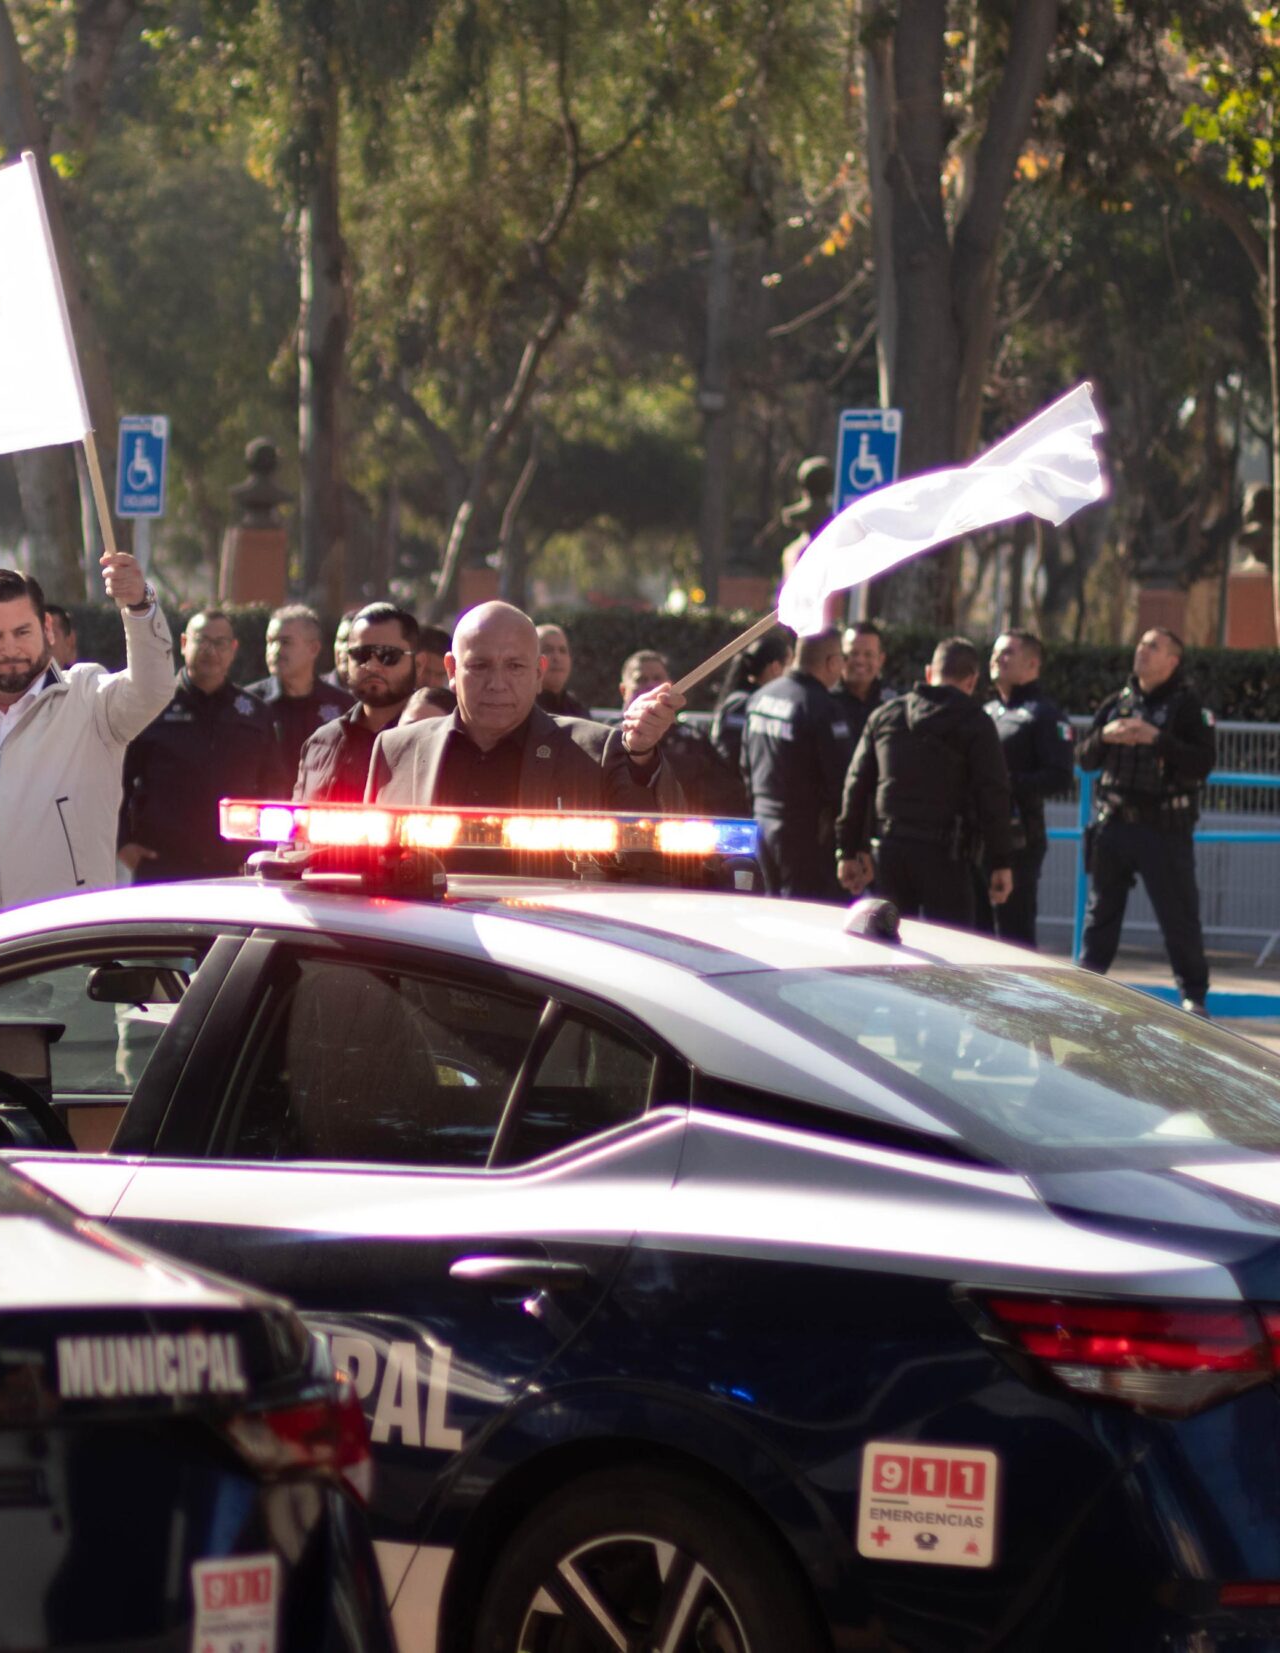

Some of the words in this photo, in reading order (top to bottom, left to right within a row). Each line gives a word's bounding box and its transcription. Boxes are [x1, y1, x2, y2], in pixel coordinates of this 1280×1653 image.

[57, 1333, 246, 1399] MUNICIPAL
[880, 1461, 974, 1495] 911
[870, 1508, 984, 1528] EMERGENCIAS
[208, 1573, 267, 1609] 911
